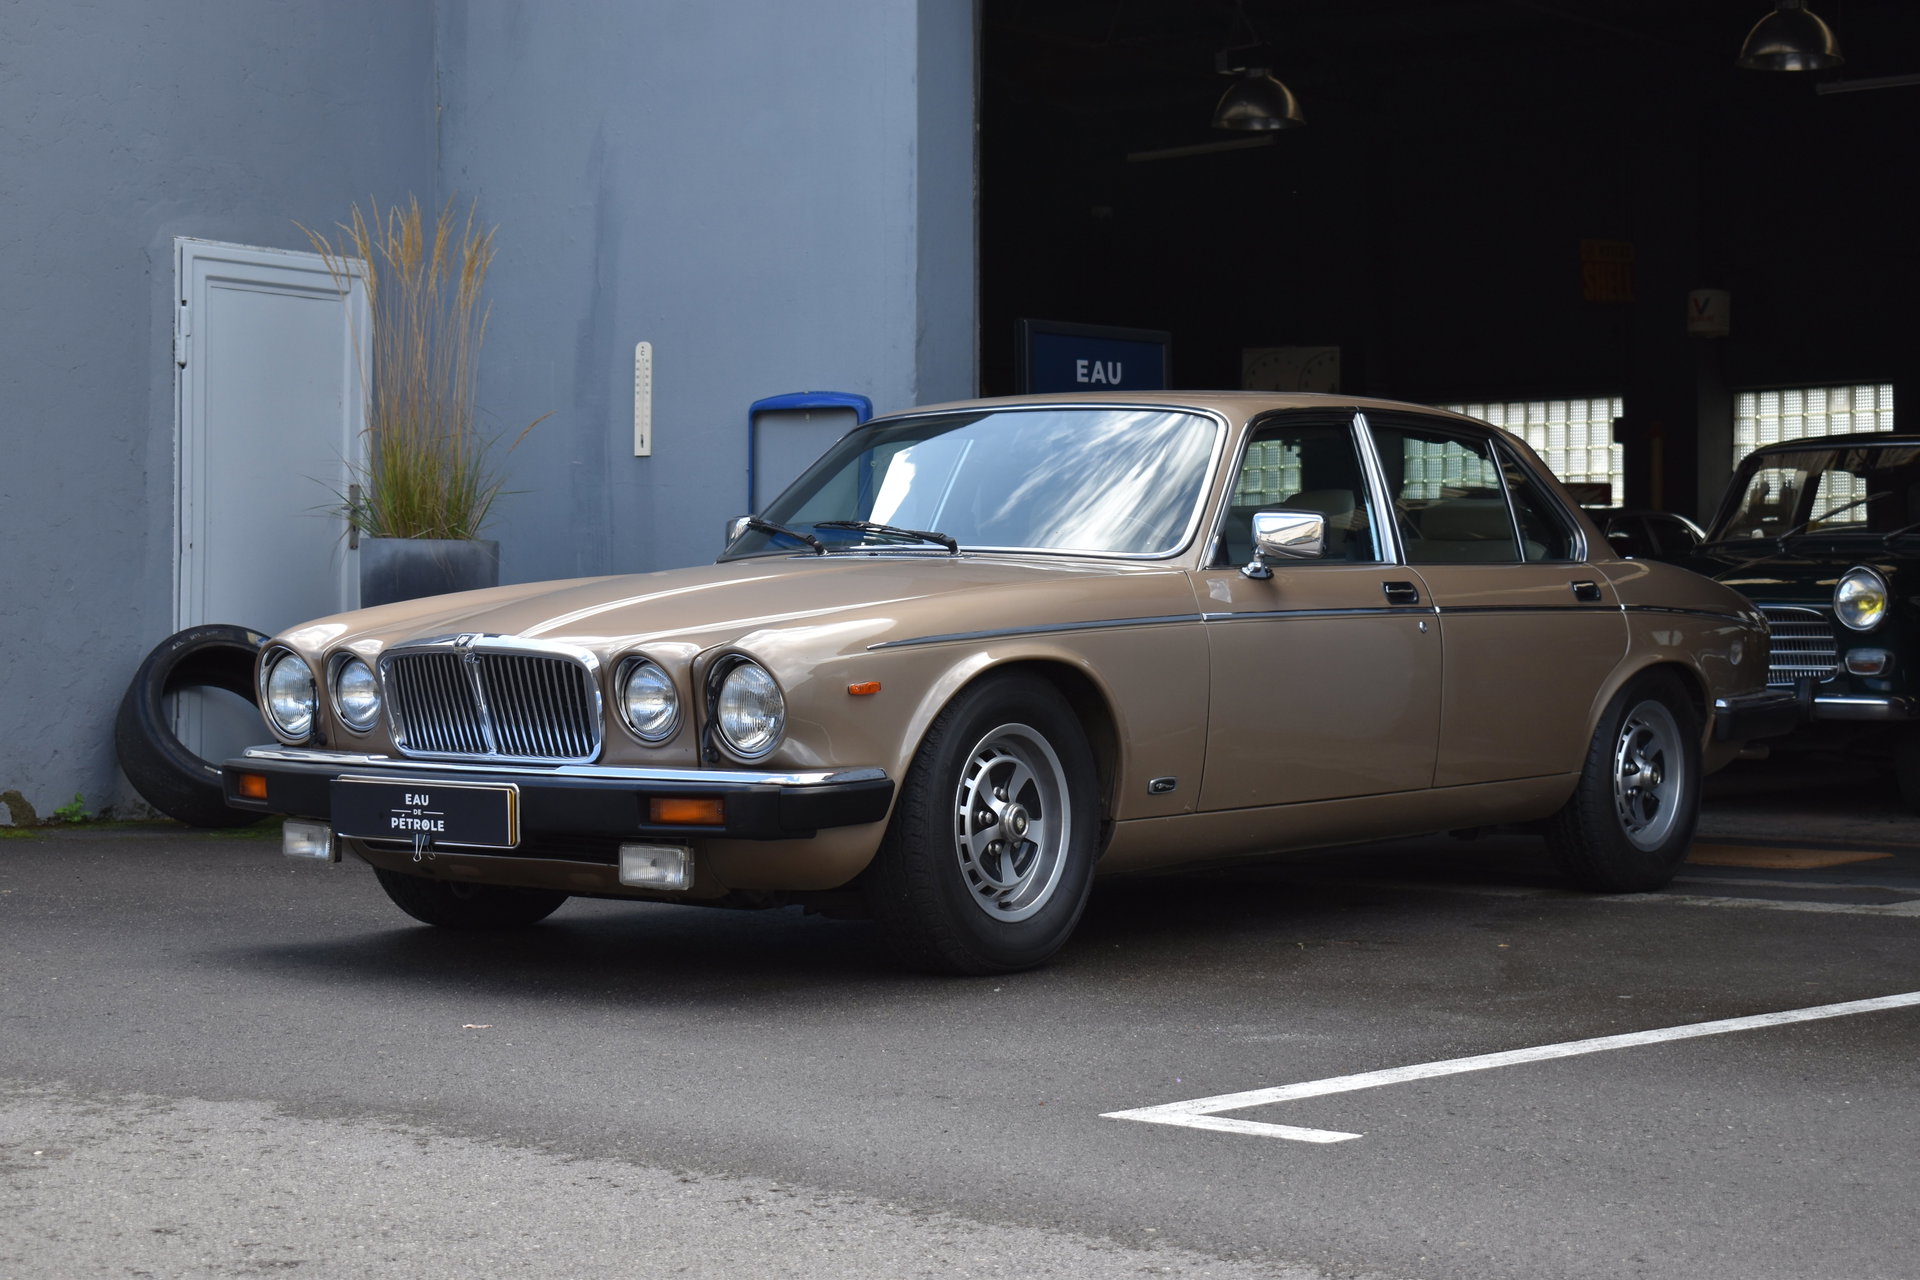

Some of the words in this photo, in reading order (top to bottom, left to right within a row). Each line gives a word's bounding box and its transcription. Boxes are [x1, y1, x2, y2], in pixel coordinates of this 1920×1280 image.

[1076, 359, 1122, 385] EAU
[405, 793, 429, 806] EAU
[391, 813, 445, 832] PÉTROLE
